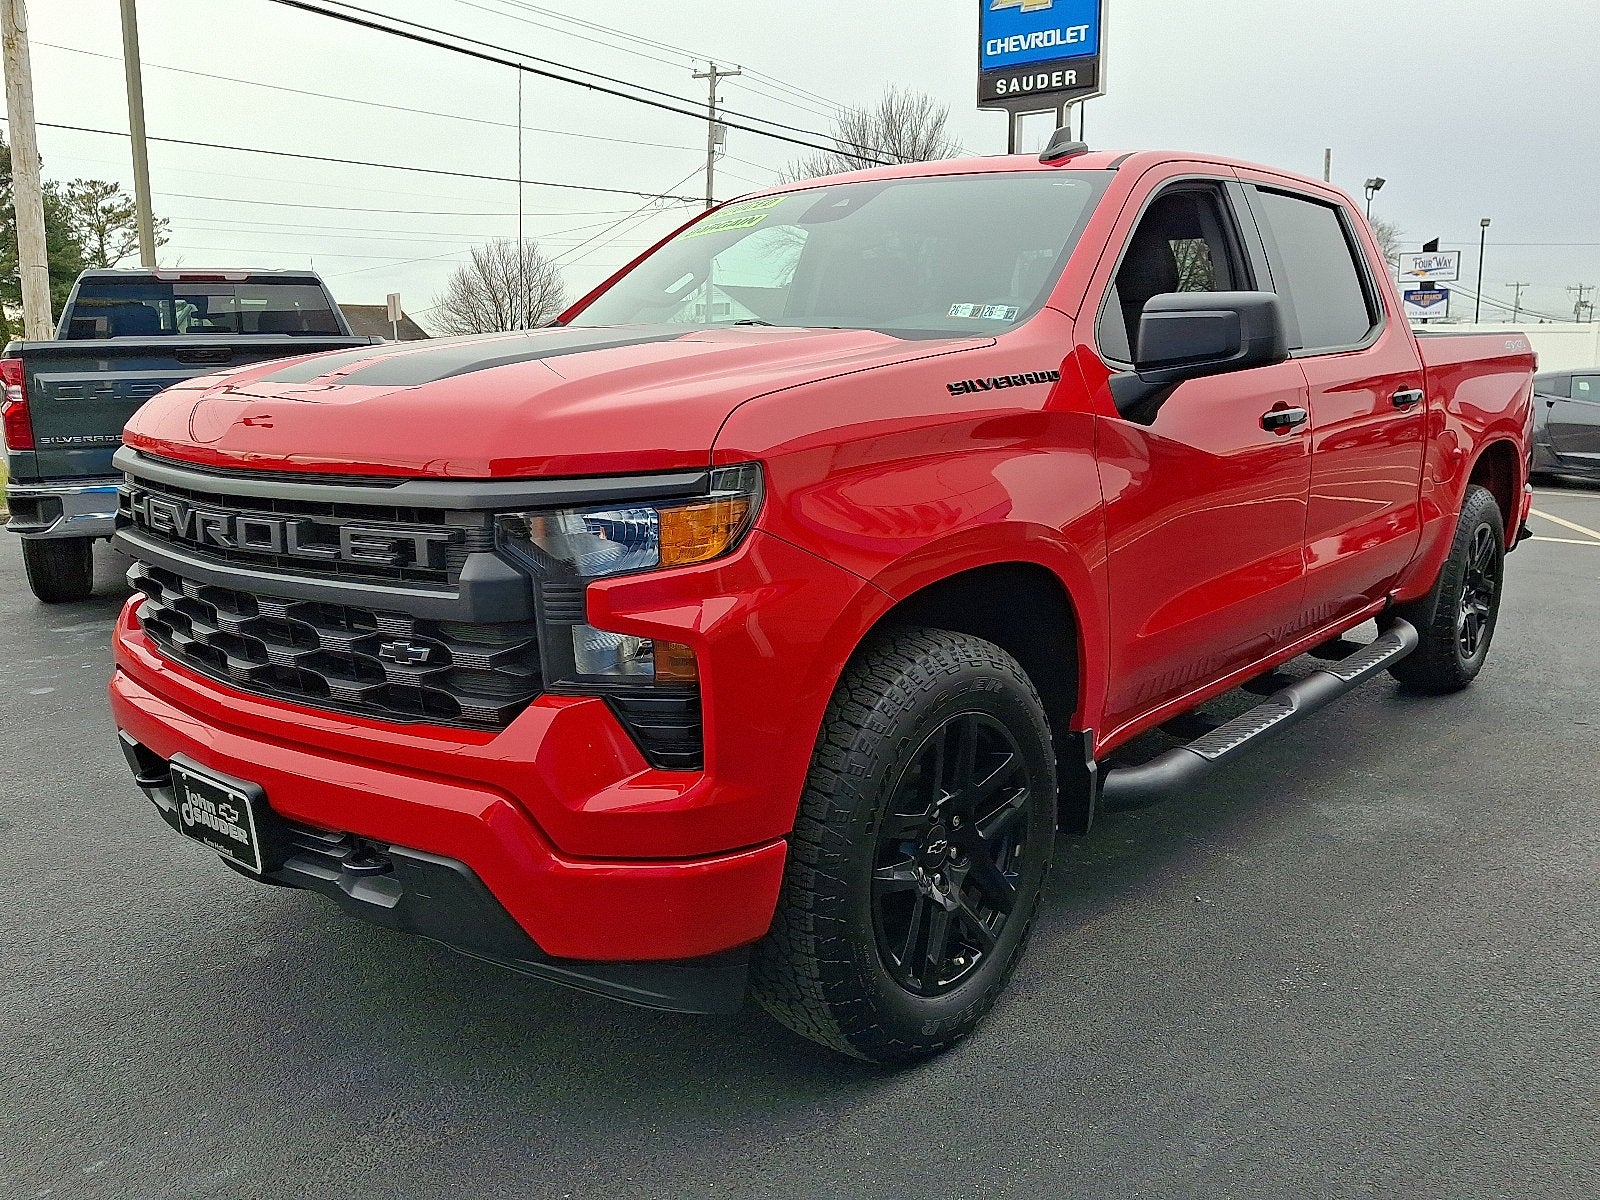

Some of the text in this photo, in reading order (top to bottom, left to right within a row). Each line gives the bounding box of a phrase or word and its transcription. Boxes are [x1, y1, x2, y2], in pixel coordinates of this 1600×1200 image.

[986, 24, 1090, 56] CHEVROLET
[995, 69, 1077, 95] SAUDER
[984, 306, 996, 317] 26
[192, 806, 249, 846] SAUDER
